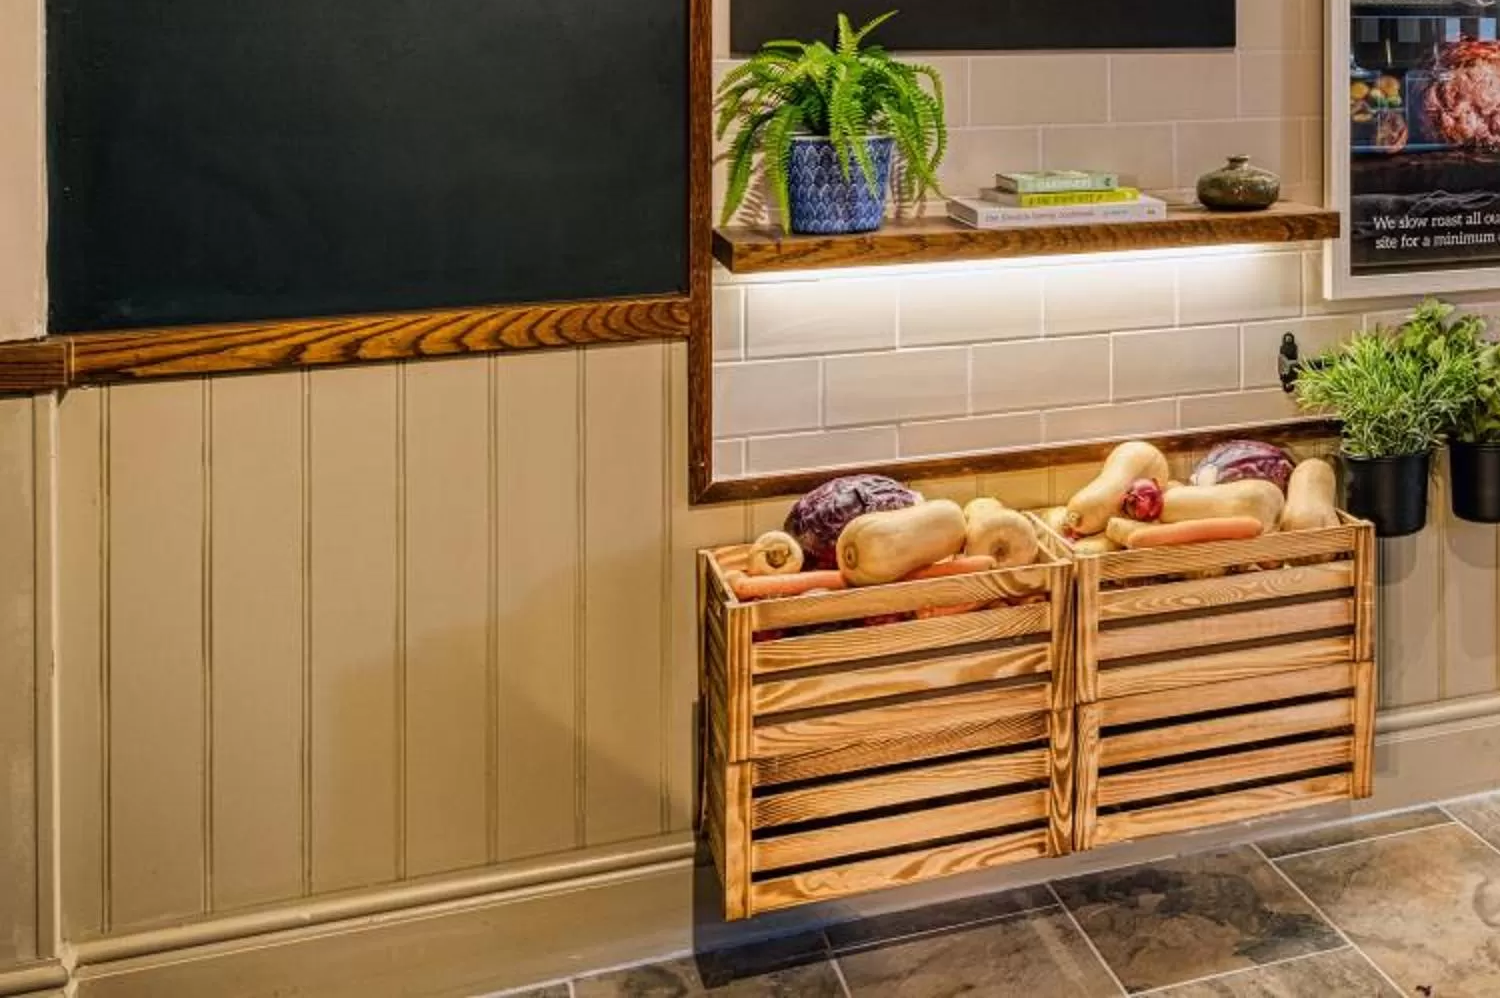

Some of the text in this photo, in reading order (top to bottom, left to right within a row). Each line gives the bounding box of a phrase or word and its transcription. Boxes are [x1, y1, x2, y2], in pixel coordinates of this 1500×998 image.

[1373, 216, 1396, 229] We
[1400, 215, 1428, 229] slow
[1432, 215, 1463, 227] roast
[1466, 211, 1481, 225] all
[1376, 236, 1397, 249] site
[1401, 234, 1418, 248] for
[1422, 237, 1430, 247] a
[1433, 231, 1495, 246] minimum
